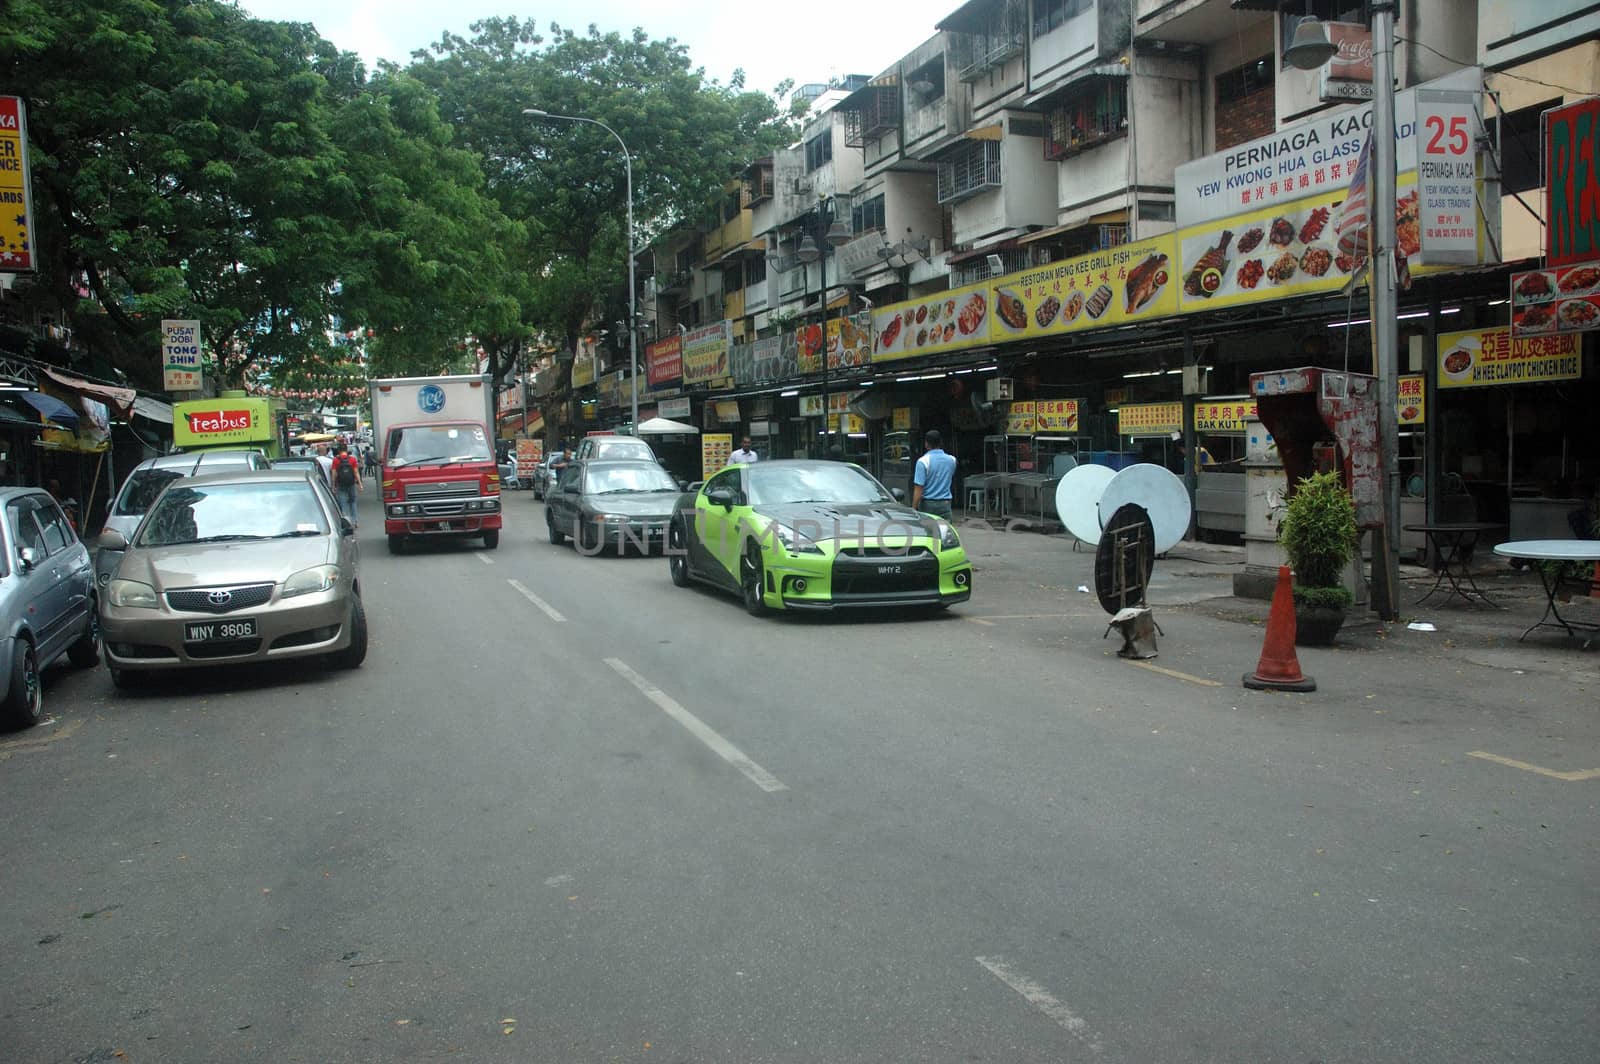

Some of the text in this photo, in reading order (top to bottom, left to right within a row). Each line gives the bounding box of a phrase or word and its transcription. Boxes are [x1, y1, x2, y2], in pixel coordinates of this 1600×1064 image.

[1337, 87, 1374, 97] HOCK SEN
[1425, 115, 1468, 155] 25
[1225, 110, 1373, 172] PERNIAGA KAC
[1196, 180, 1221, 197] YEW
[1226, 166, 1272, 190] KWONG
[1278, 157, 1306, 176] HUA
[1312, 139, 1361, 163] GLASS
[1421, 162, 1474, 179] PERNIAGA KACA
[1425, 185, 1473, 195] YEW KWONG HUA
[1427, 199, 1471, 208] GLASS TRADING
[1020, 270, 1054, 287] RESTORAN
[1055, 264, 1074, 279] MENG
[1075, 260, 1089, 273] KEE
[1090, 255, 1112, 270] GRILL
[1113, 250, 1130, 265] FISH
[167, 327, 195, 335] PUSAT
[171, 336, 193, 344] DOBI
[167, 346, 198, 355] TONG
[169, 355, 195, 364] SHIN
[1496, 361, 1526, 379] CLAYPOT
[1527, 359, 1559, 377] CHICKEN
[1559, 357, 1577, 374] RICE
[192, 410, 248, 432] teabus
[1198, 420, 1216, 429] BAK
[1218, 420, 1238, 429] KUT
[878, 566, 894, 574] WHY
[190, 622, 252, 640] WNY 3606
